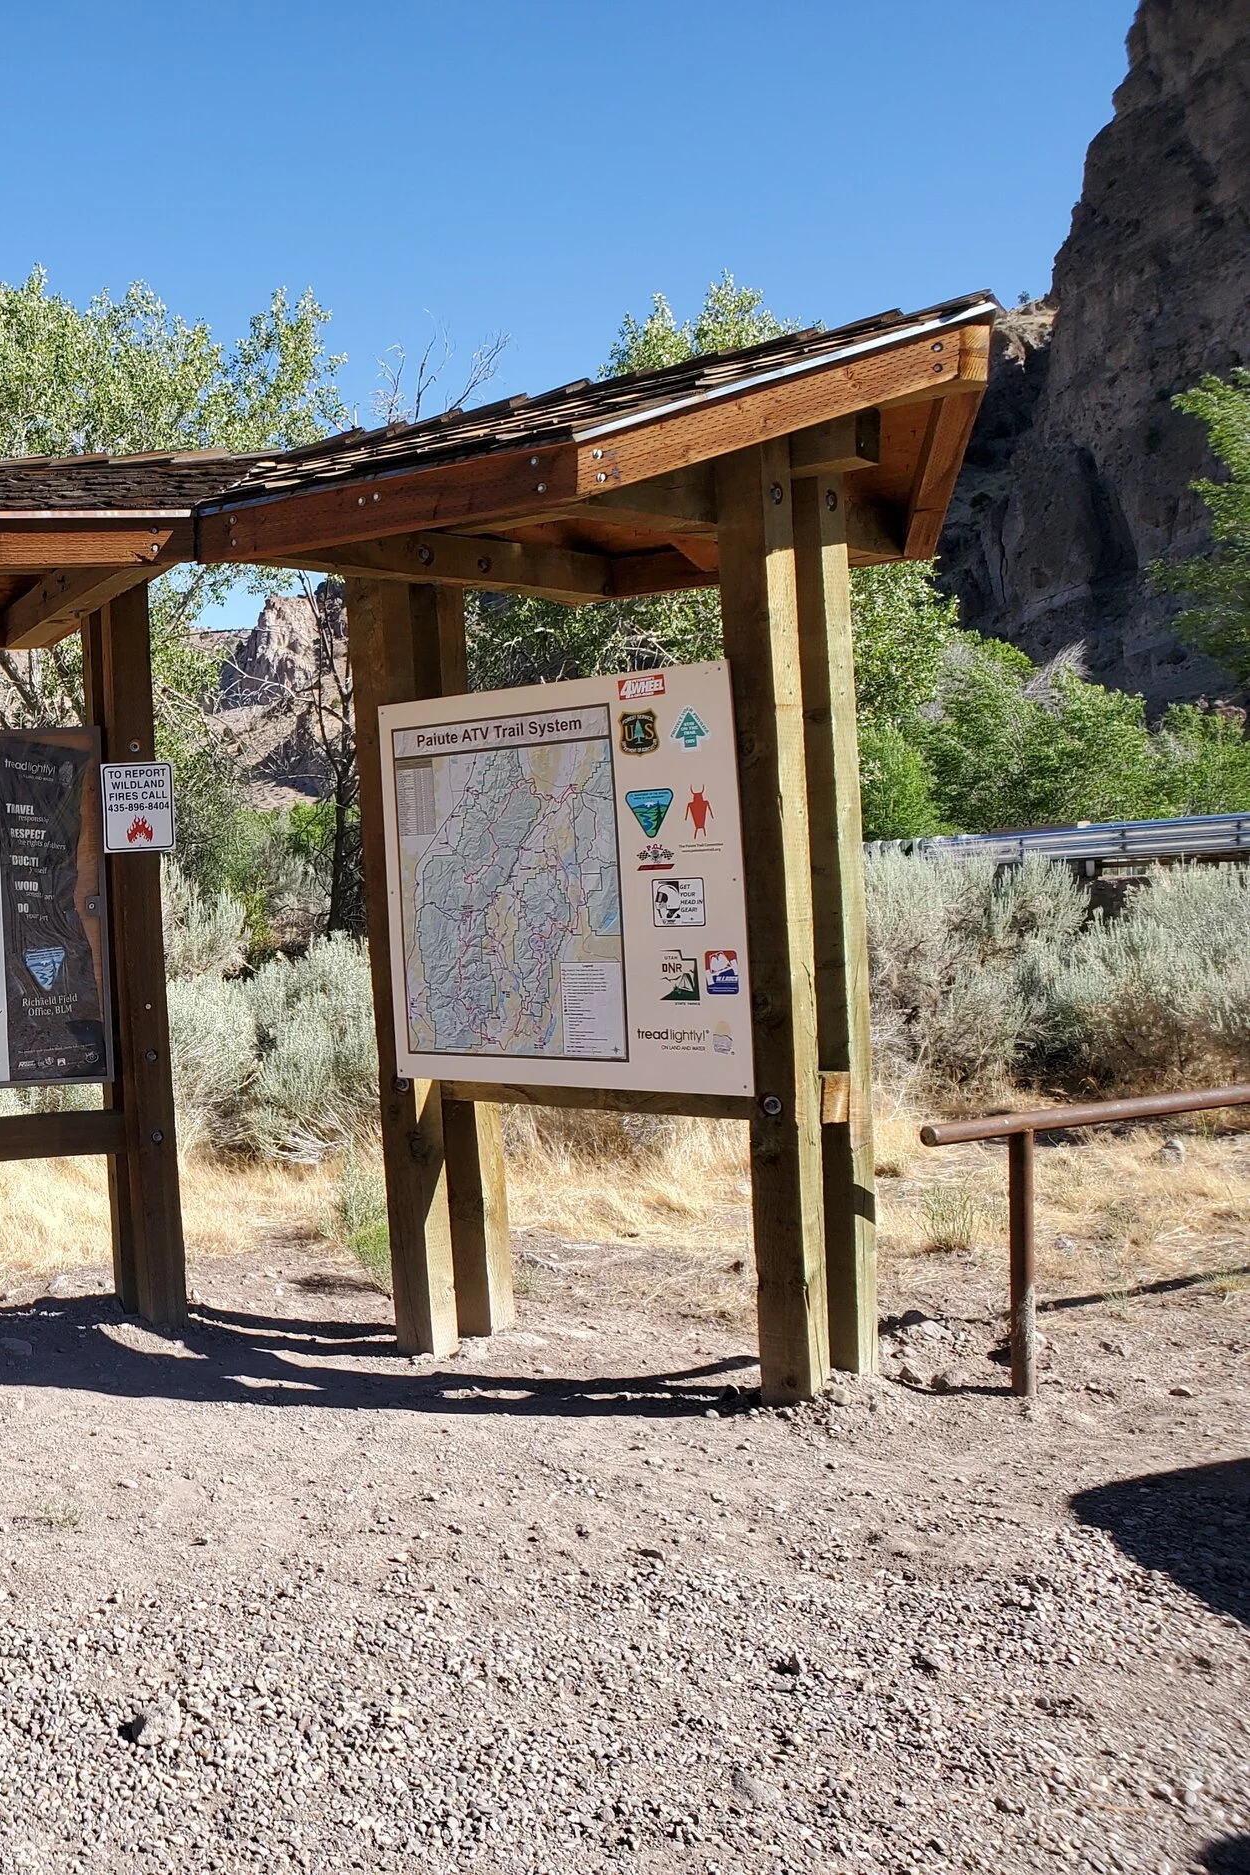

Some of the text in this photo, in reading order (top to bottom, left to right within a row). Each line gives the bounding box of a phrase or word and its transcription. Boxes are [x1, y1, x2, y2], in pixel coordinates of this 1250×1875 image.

[417, 717, 582, 748] Paiute ATV Trail System
[625, 723, 654, 741] U S
[108, 768, 166, 779] TO REPORT
[111, 780, 164, 789] WILDLAND
[109, 791, 167, 801] FIRES CALL
[6, 803, 34, 815] TRAVEL
[108, 802, 169, 812] 435-896-8404
[10, 828, 46, 840] RESPECT
[18, 903, 29, 913] DO
[662, 962, 682, 973] DNR
[58, 993, 78, 1003] Field
[28, 1004, 72, 1016] Office, BLM
